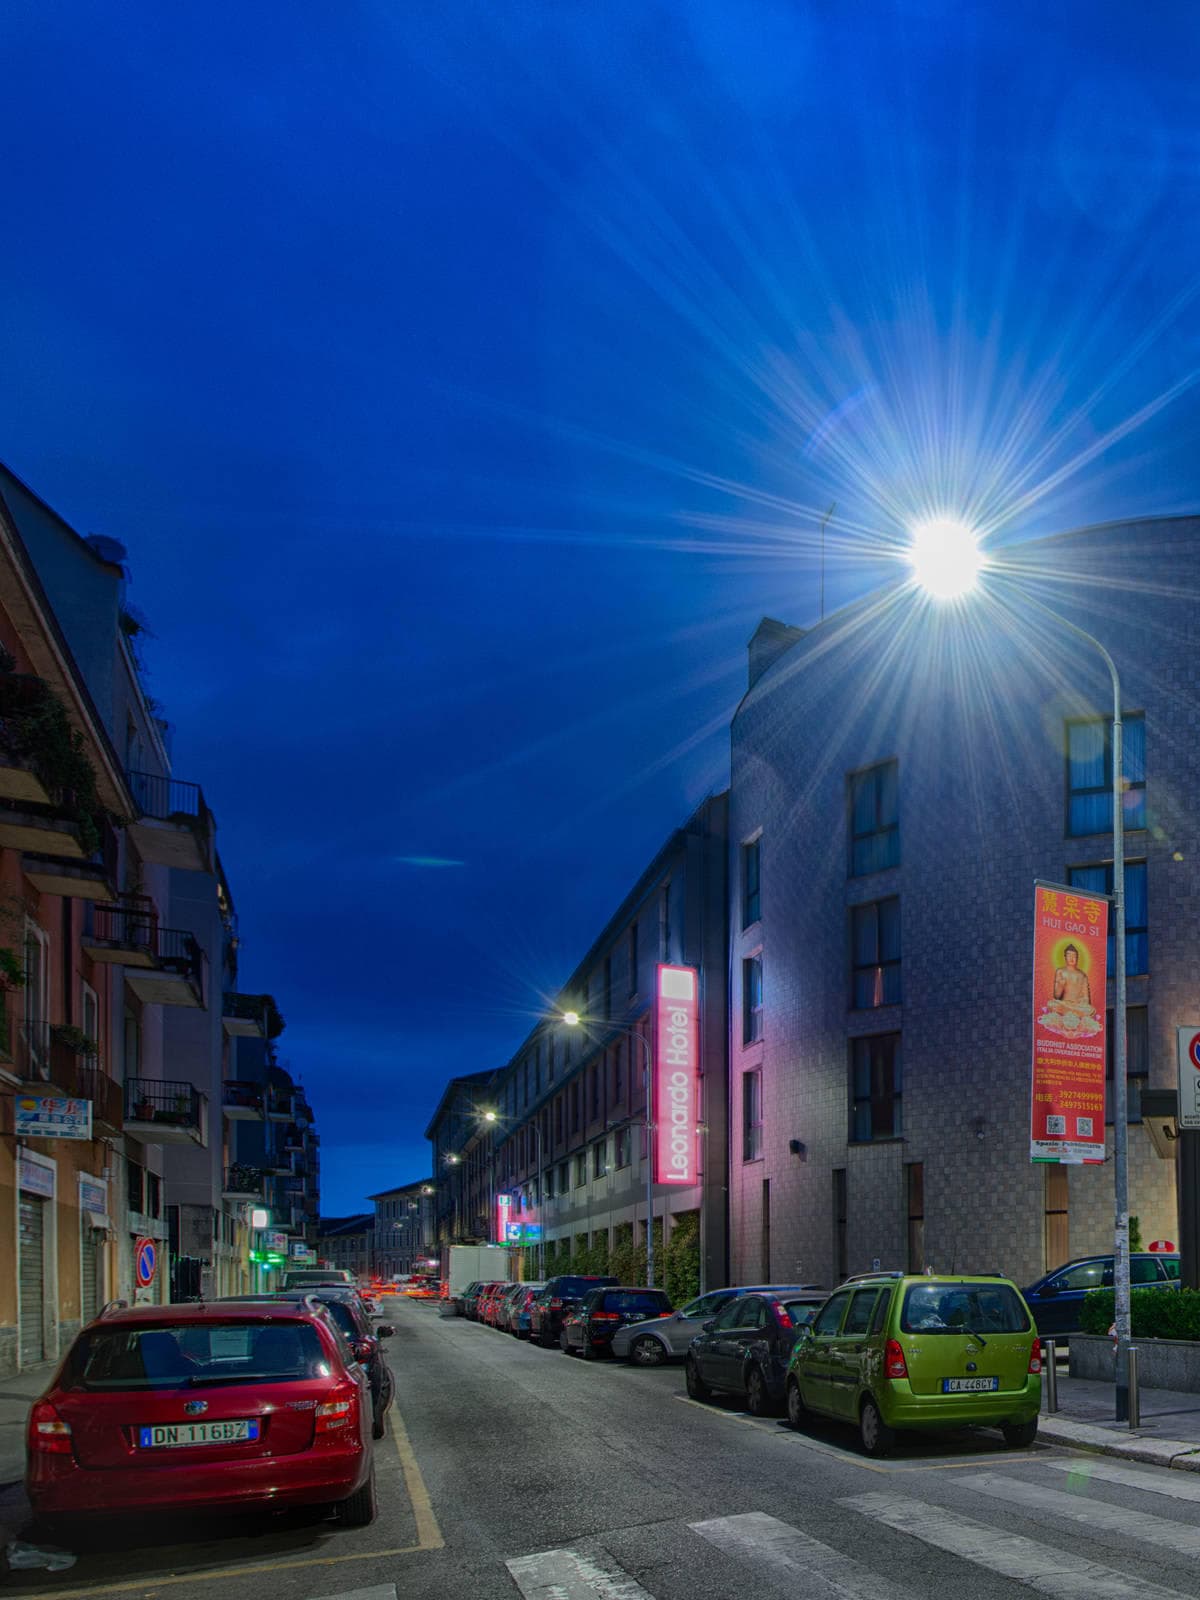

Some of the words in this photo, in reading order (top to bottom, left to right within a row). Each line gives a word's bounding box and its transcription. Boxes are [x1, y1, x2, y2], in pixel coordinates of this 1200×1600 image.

[1042, 916, 1061, 929] HUI
[1064, 920, 1087, 934] GAO
[1089, 926, 1100, 937] SI
[666, 1005, 689, 1066] Hotel
[666, 1071, 689, 1181] Leonardo
